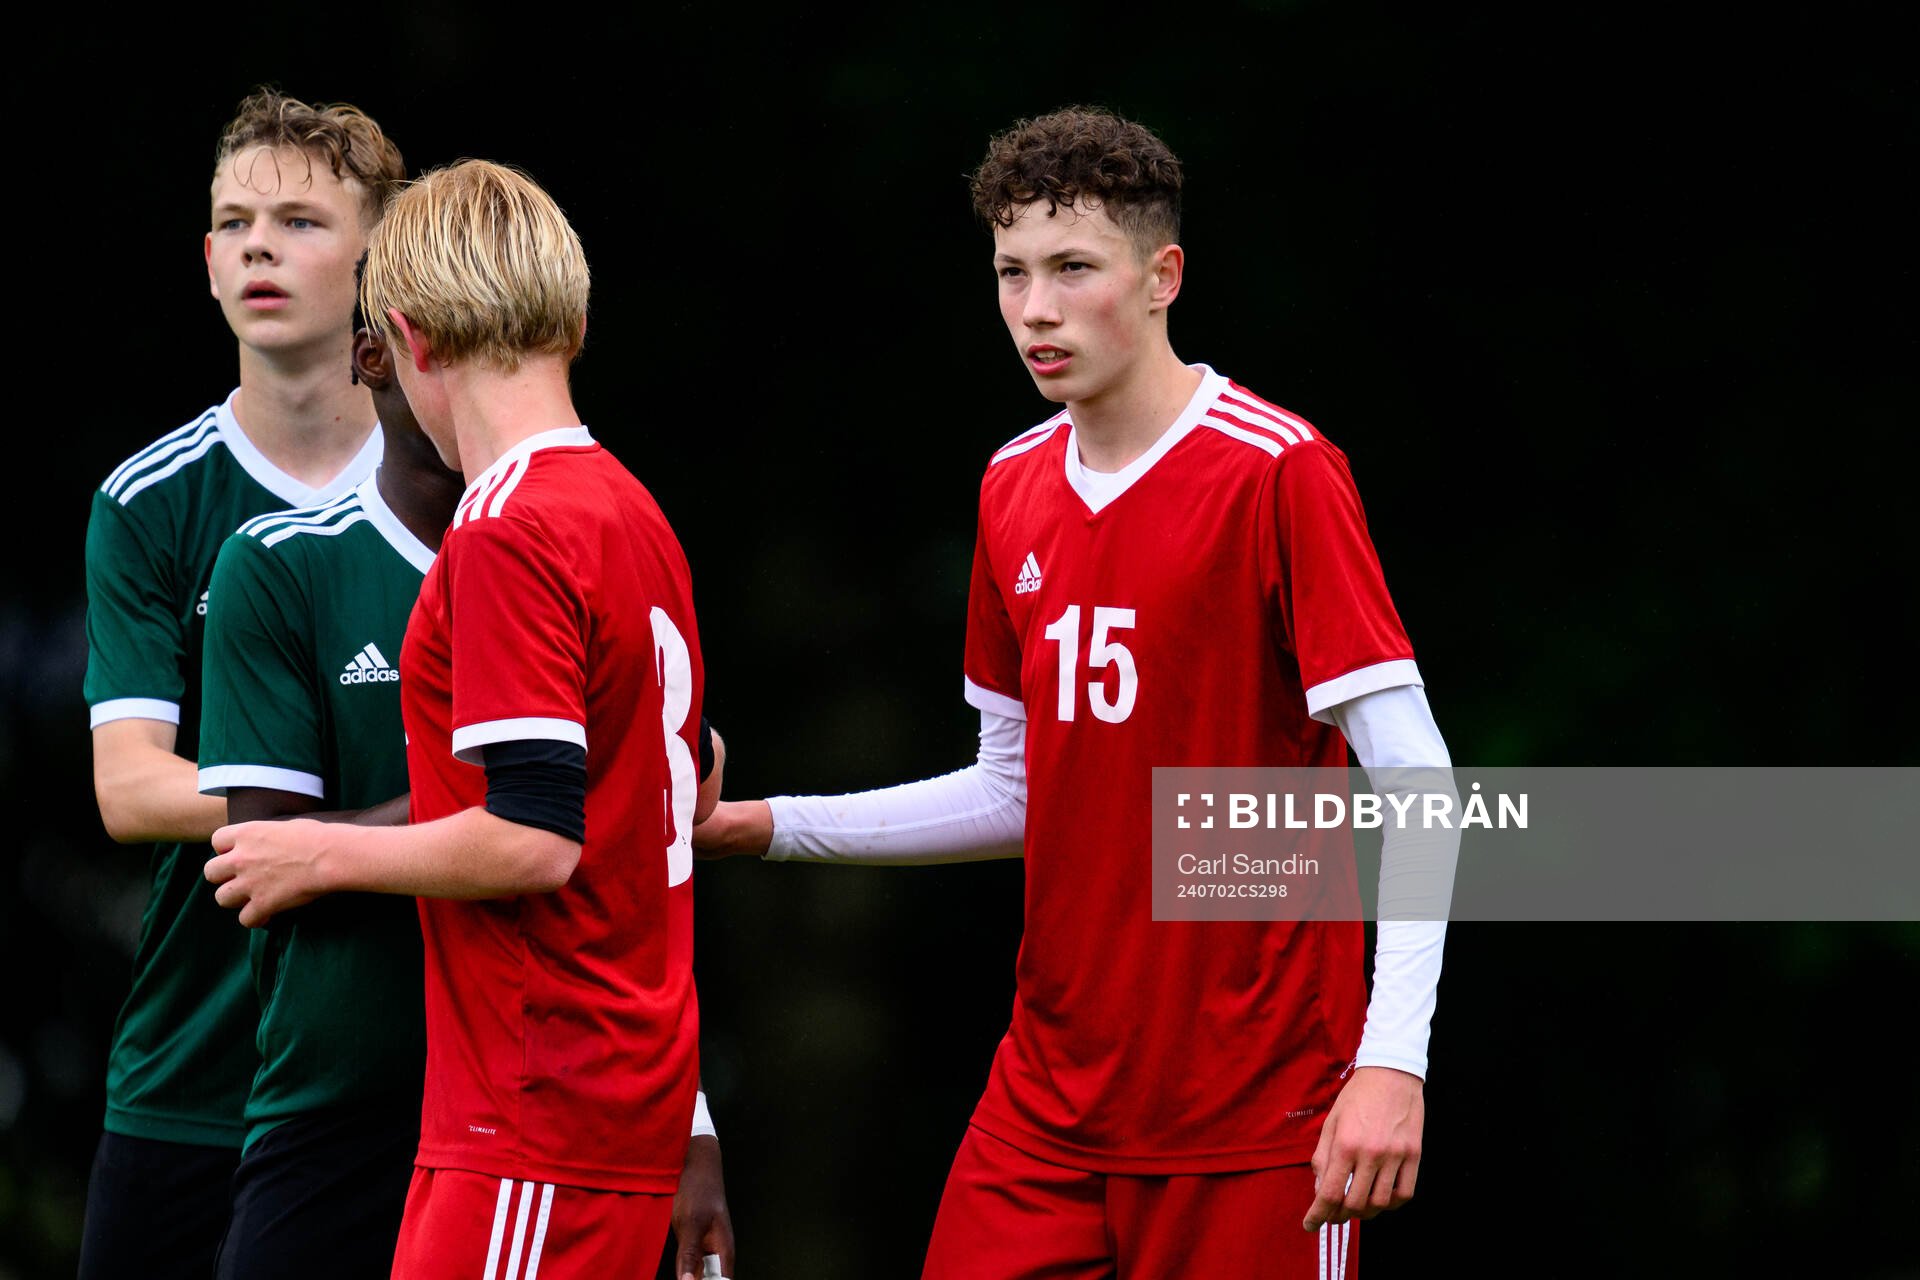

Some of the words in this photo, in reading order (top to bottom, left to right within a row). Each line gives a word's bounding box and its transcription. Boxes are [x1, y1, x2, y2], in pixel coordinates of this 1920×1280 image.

[340, 667, 399, 685] adidas
[1045, 604, 1138, 724] 15
[650, 606, 697, 888] 3
